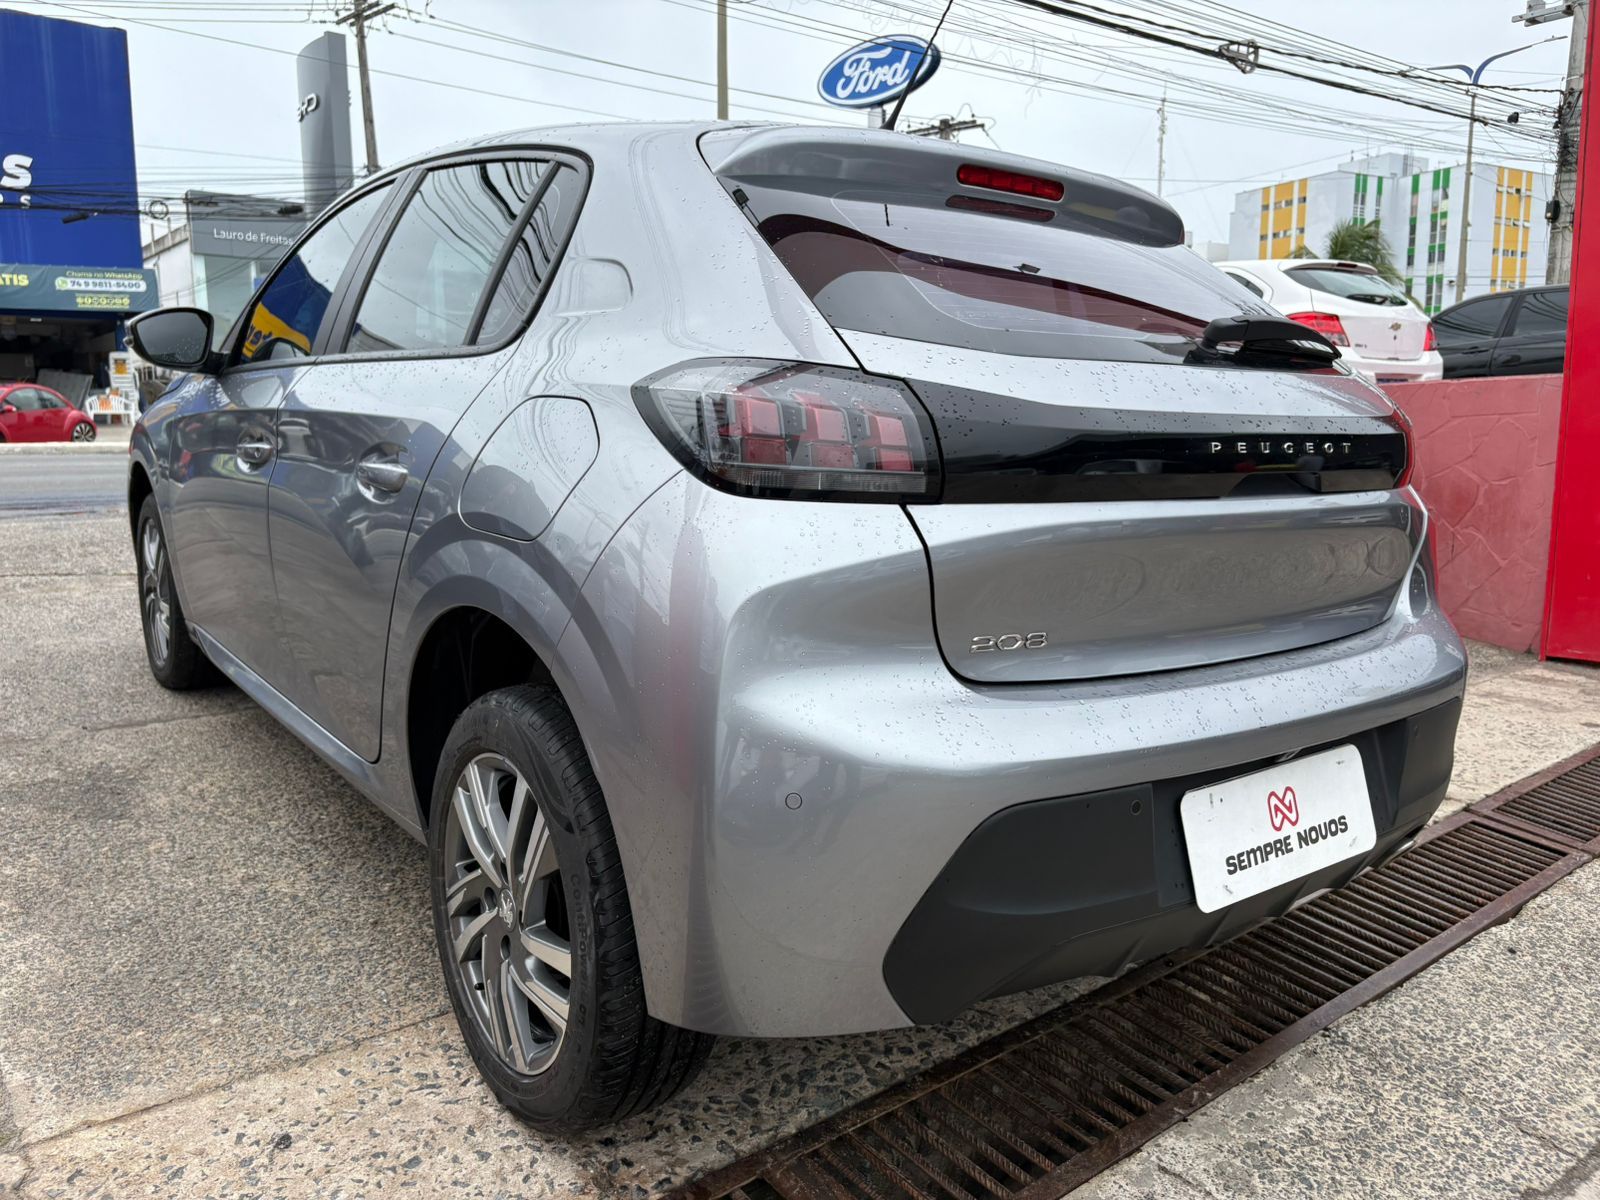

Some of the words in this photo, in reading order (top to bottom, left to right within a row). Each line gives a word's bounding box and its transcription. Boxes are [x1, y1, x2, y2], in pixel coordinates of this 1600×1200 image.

[836, 46, 911, 98] Ford
[213, 227, 244, 240] Lauro
[245, 230, 259, 242] de
[1211, 442, 1351, 454] PEUGEOT
[969, 632, 1048, 653] 208
[1225, 834, 1294, 875] SEMPRE
[1296, 814, 1349, 849] NOVOS
